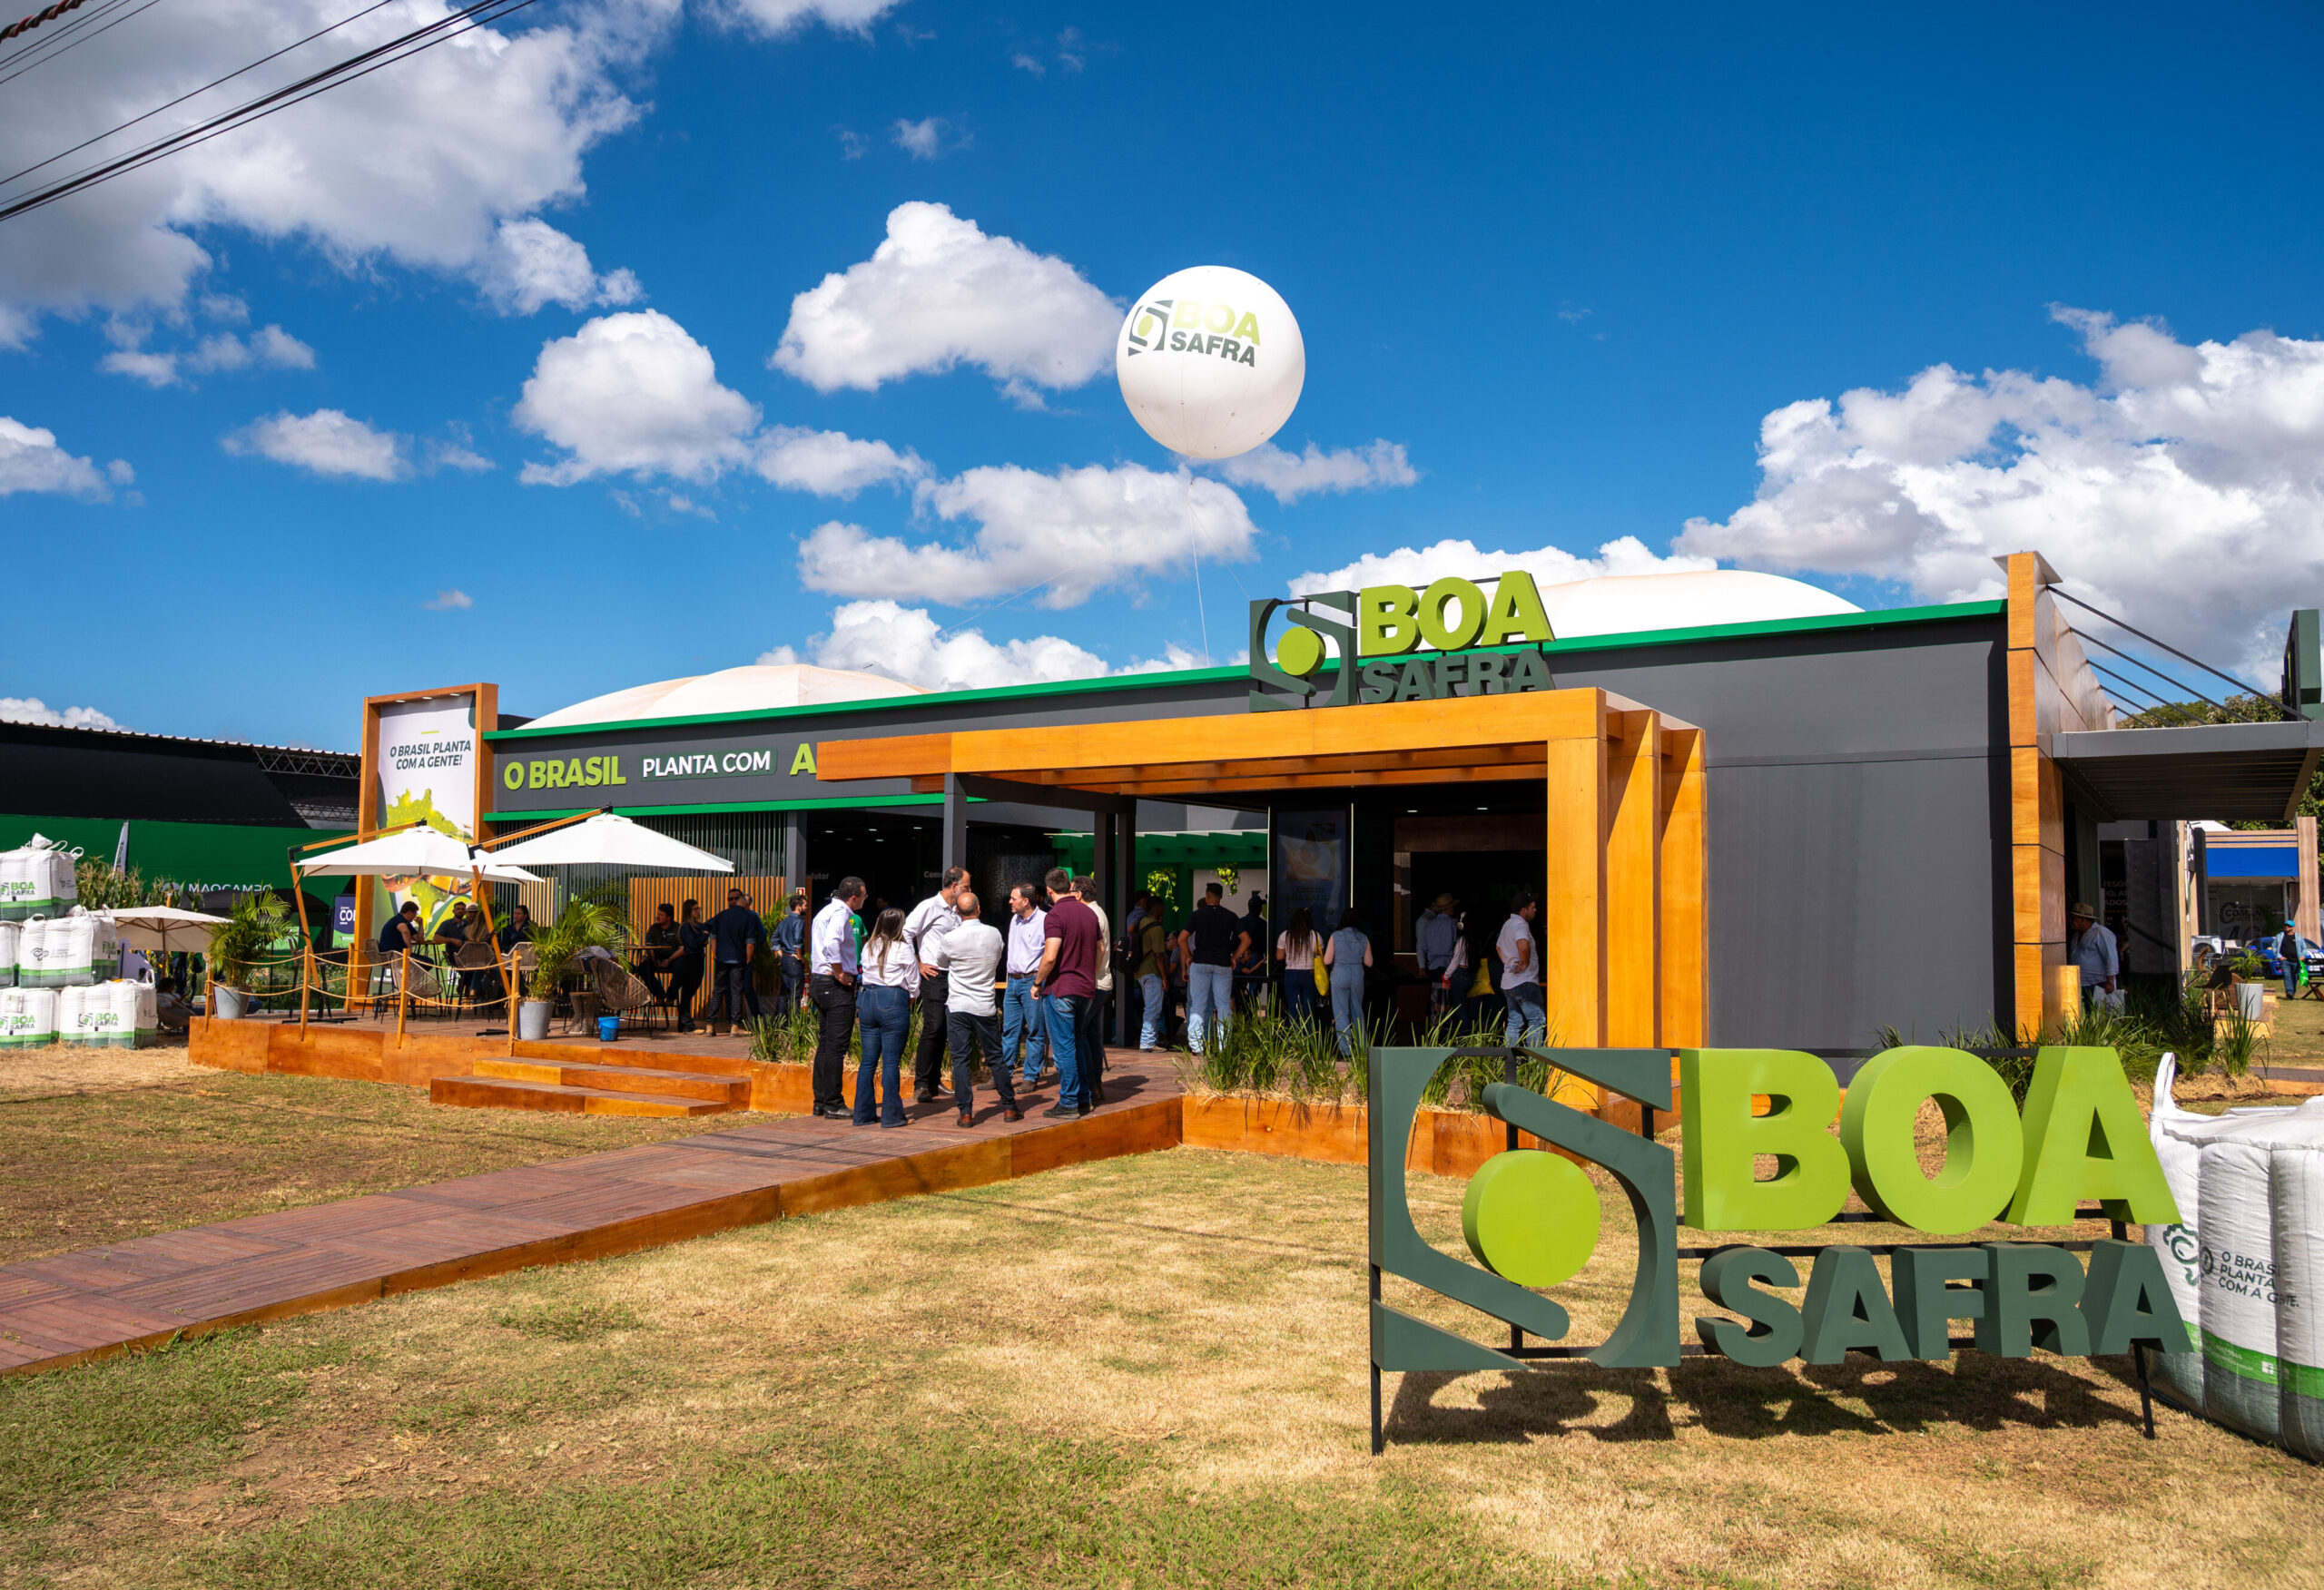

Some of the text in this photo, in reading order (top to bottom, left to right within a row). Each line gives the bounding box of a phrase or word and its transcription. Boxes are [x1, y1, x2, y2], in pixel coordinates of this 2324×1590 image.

[1173, 299, 1261, 347] BOA
[1170, 330, 1255, 368] SAFRA
[1360, 570, 1556, 657] BOA
[1363, 648, 1556, 704] SAFRA
[389, 740, 471, 758] O BRASIL PLANTA
[396, 754, 463, 770] COM A GENTE!
[503, 742, 817, 791] O BRASIL PLANTA COM A
[10, 881, 35, 890] BOA
[10, 1016, 35, 1025] BOA
[95, 1012, 119, 1021] BOA
[1680, 1045, 2181, 1235] BOA
[2221, 1251, 2231, 1262] O
[2218, 1276, 2248, 1296] COM
[2250, 1287, 2262, 1300] A
[2220, 1263, 2276, 1290] PLANTA
[1696, 1240, 2195, 1368] SAFRA
